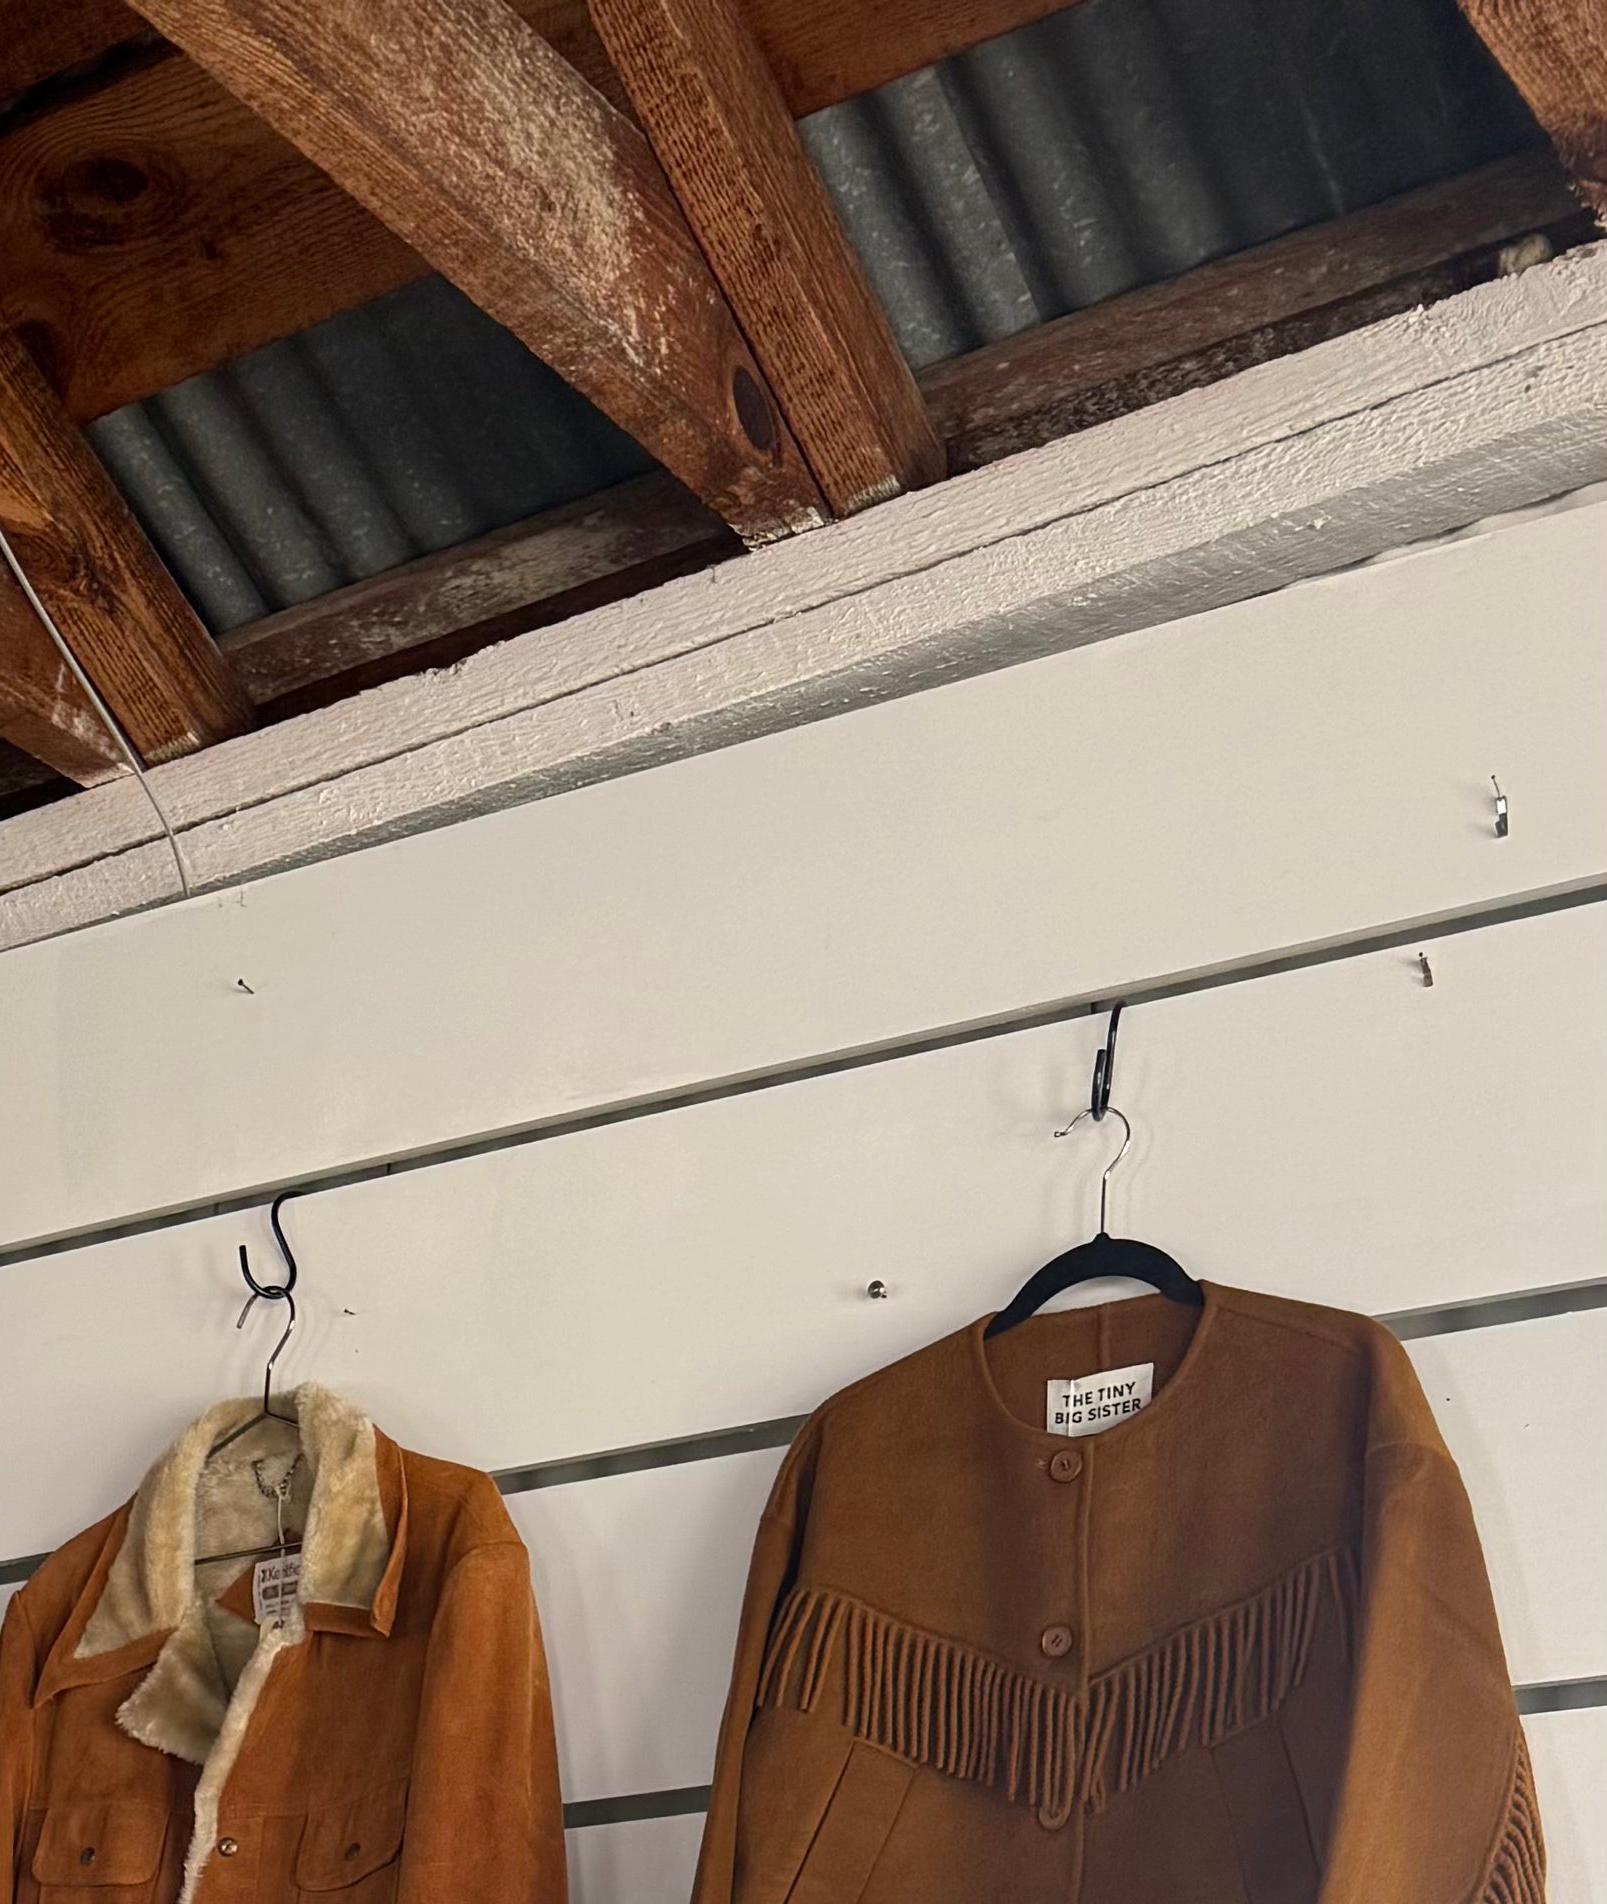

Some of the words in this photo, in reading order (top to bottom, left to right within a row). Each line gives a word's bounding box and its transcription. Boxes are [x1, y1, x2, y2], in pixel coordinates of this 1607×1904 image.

[1062, 1391, 1093, 1407] THE
[1097, 1381, 1136, 1401] TINY
[1054, 1411, 1082, 1424] BIG
[1087, 1398, 1141, 1421] SISTER
